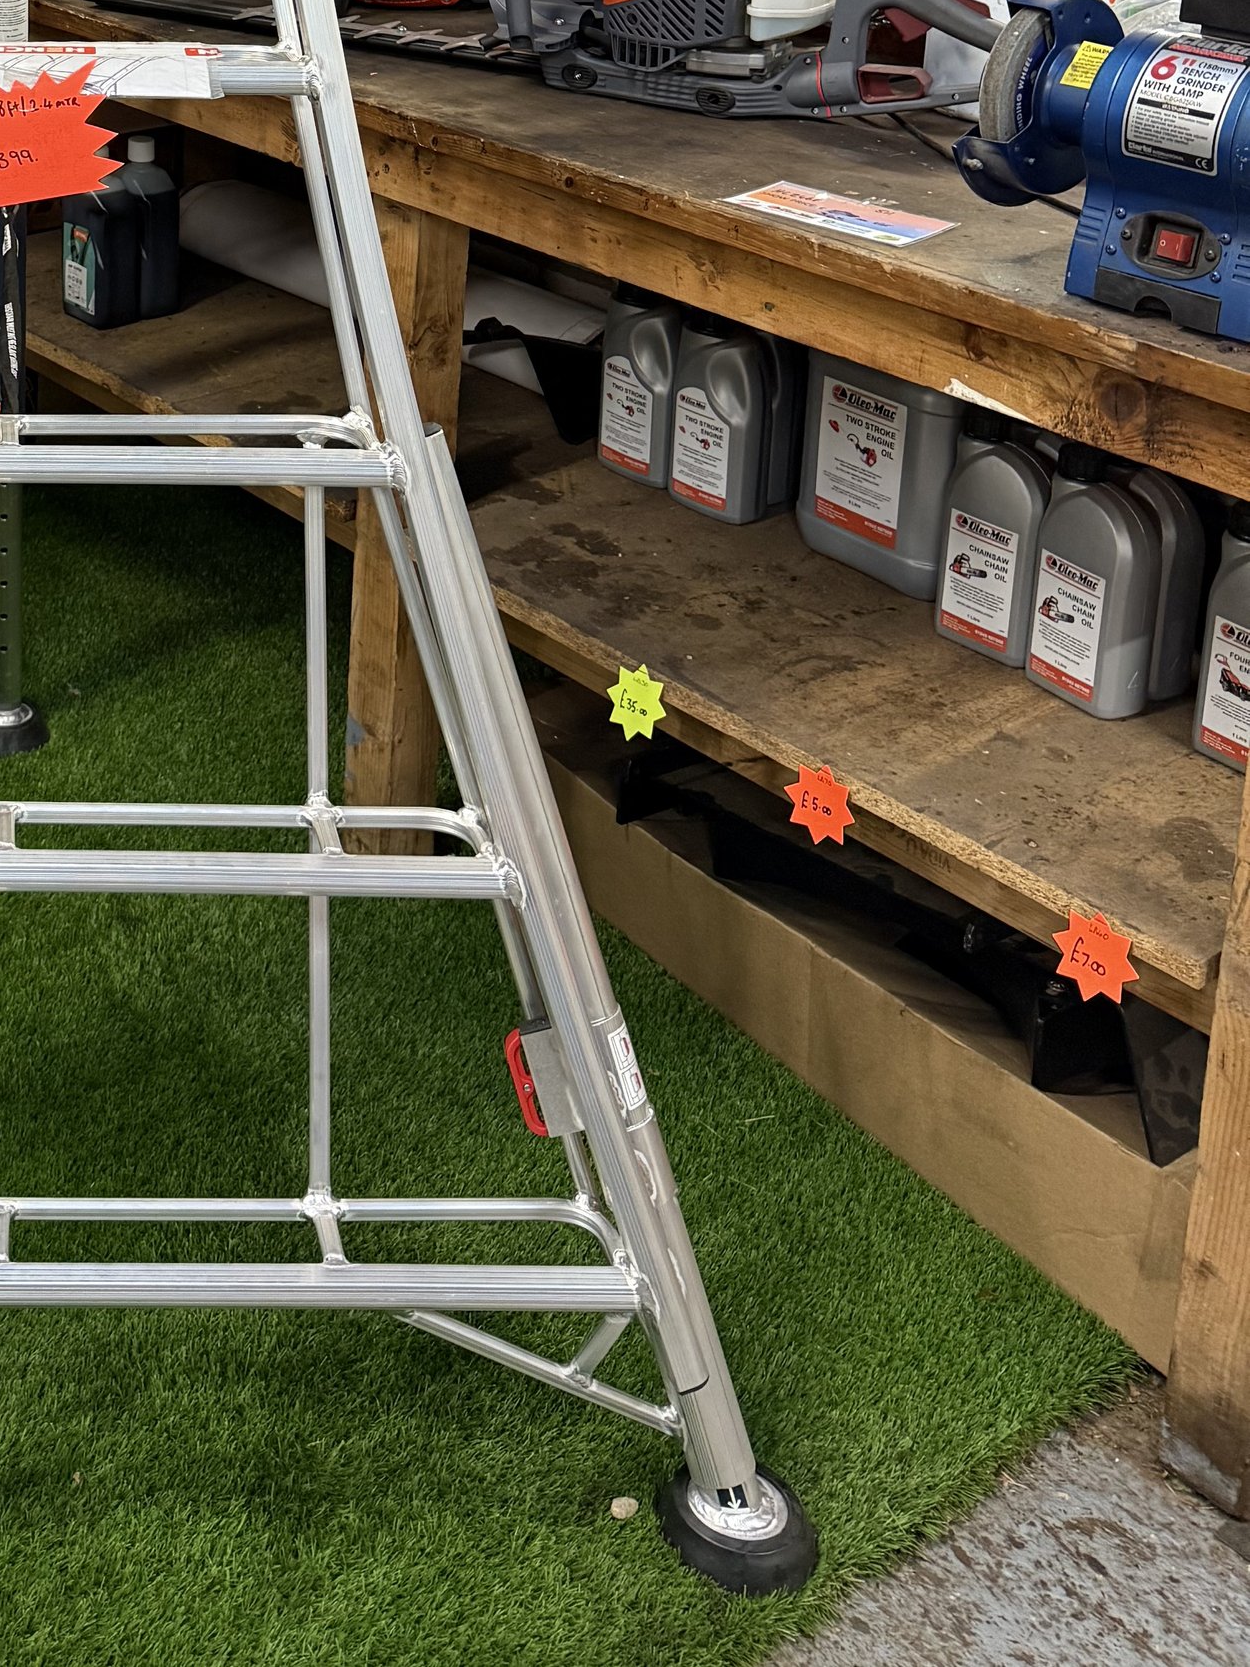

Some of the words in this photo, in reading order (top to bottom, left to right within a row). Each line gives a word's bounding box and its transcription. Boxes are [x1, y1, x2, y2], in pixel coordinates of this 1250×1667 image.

[1017, 57, 1033, 90] WHEEL
[1181, 67, 1221, 81] BENCH
[1143, 80, 1171, 93] WITH
[1172, 86, 1204, 100] LAMP
[1176, 76, 1226, 94] GRINDER
[612, 382, 624, 392] TWO
[625, 388, 647, 400] STROKE
[625, 396, 647, 408] ENGINE
[636, 407, 646, 415] OIL
[847, 392, 897, 420] Oleo-Mac
[685, 415, 698, 425] TWO
[699, 420, 724, 433] STROKE
[846, 414, 864, 427] TWO
[864, 421, 897, 440] STROKE
[700, 428, 724, 441] ENGINE
[866, 432, 895, 451] ENGINE
[712, 440, 723, 448] OIL
[881, 449, 895, 460] OIL
[968, 521, 1012, 545] Oleo-Mac
[969, 544, 1010, 566] CHAINSAW
[984, 560, 1008, 574] CHAIN
[994, 573, 1007, 583] OIL
[1057, 563, 1098, 591] Oleo-Mac
[1057, 587, 1097, 612] CHAINSAW
[1072, 604, 1095, 621] CHAIN
[1081, 618, 1094, 630] OIL
[1070, 937, 1106, 976] £7.00
